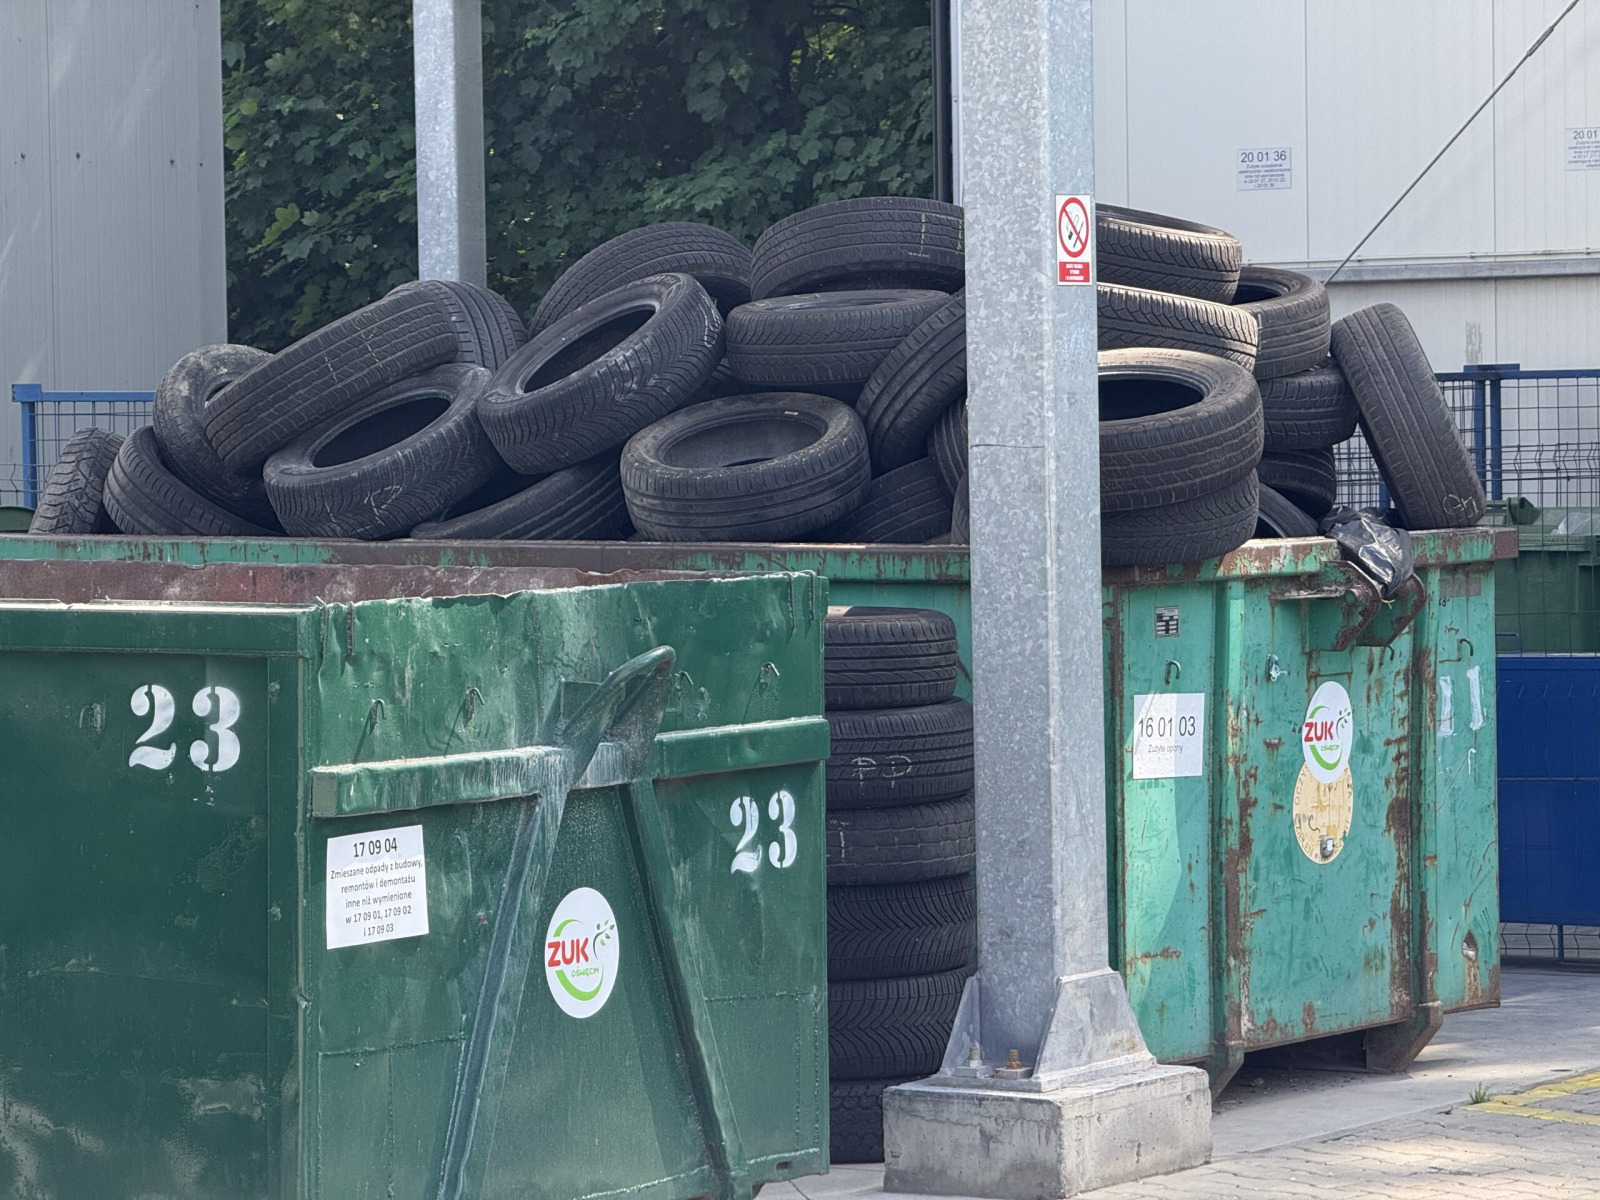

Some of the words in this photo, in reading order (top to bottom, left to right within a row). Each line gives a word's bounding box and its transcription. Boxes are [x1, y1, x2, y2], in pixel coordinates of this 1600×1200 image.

[1573, 130, 1584, 139] 20
[1587, 130, 1597, 138] 01
[1241, 152, 1254, 162] 20
[1257, 152, 1269, 162] 01
[1274, 151, 1287, 161] 36
[129, 685, 240, 771] 23
[1139, 717, 1153, 737] 16
[1158, 717, 1173, 737] 01
[1179, 716, 1196, 736] 03
[1304, 720, 1333, 742] ZUK
[1167, 745, 1183, 754] opony
[730, 790, 797, 873] 23
[353, 842, 364, 857] 17
[369, 840, 381, 855] 09
[385, 837, 397, 852] 04
[331, 868, 364, 879] Zmieszane
[366, 862, 388, 875] odpady
[341, 880, 374, 893] remontów
[380, 875, 416, 888] demontażu
[346, 899, 360, 908] inne
[362, 896, 371, 906] niż
[373, 891, 412, 904] wymienione
[354, 913, 361, 922] 17
[364, 912, 371, 920] 09
[385, 909, 392, 918] 17
[393, 907, 401, 916] 09
[403, 906, 411, 914] 02
[368, 927, 375, 936] 17
[377, 925, 384, 934] 09
[386, 923, 394, 932] 03
[548, 937, 589, 967] ZUK
[572, 967, 599, 978] OŚWIĘCIM
